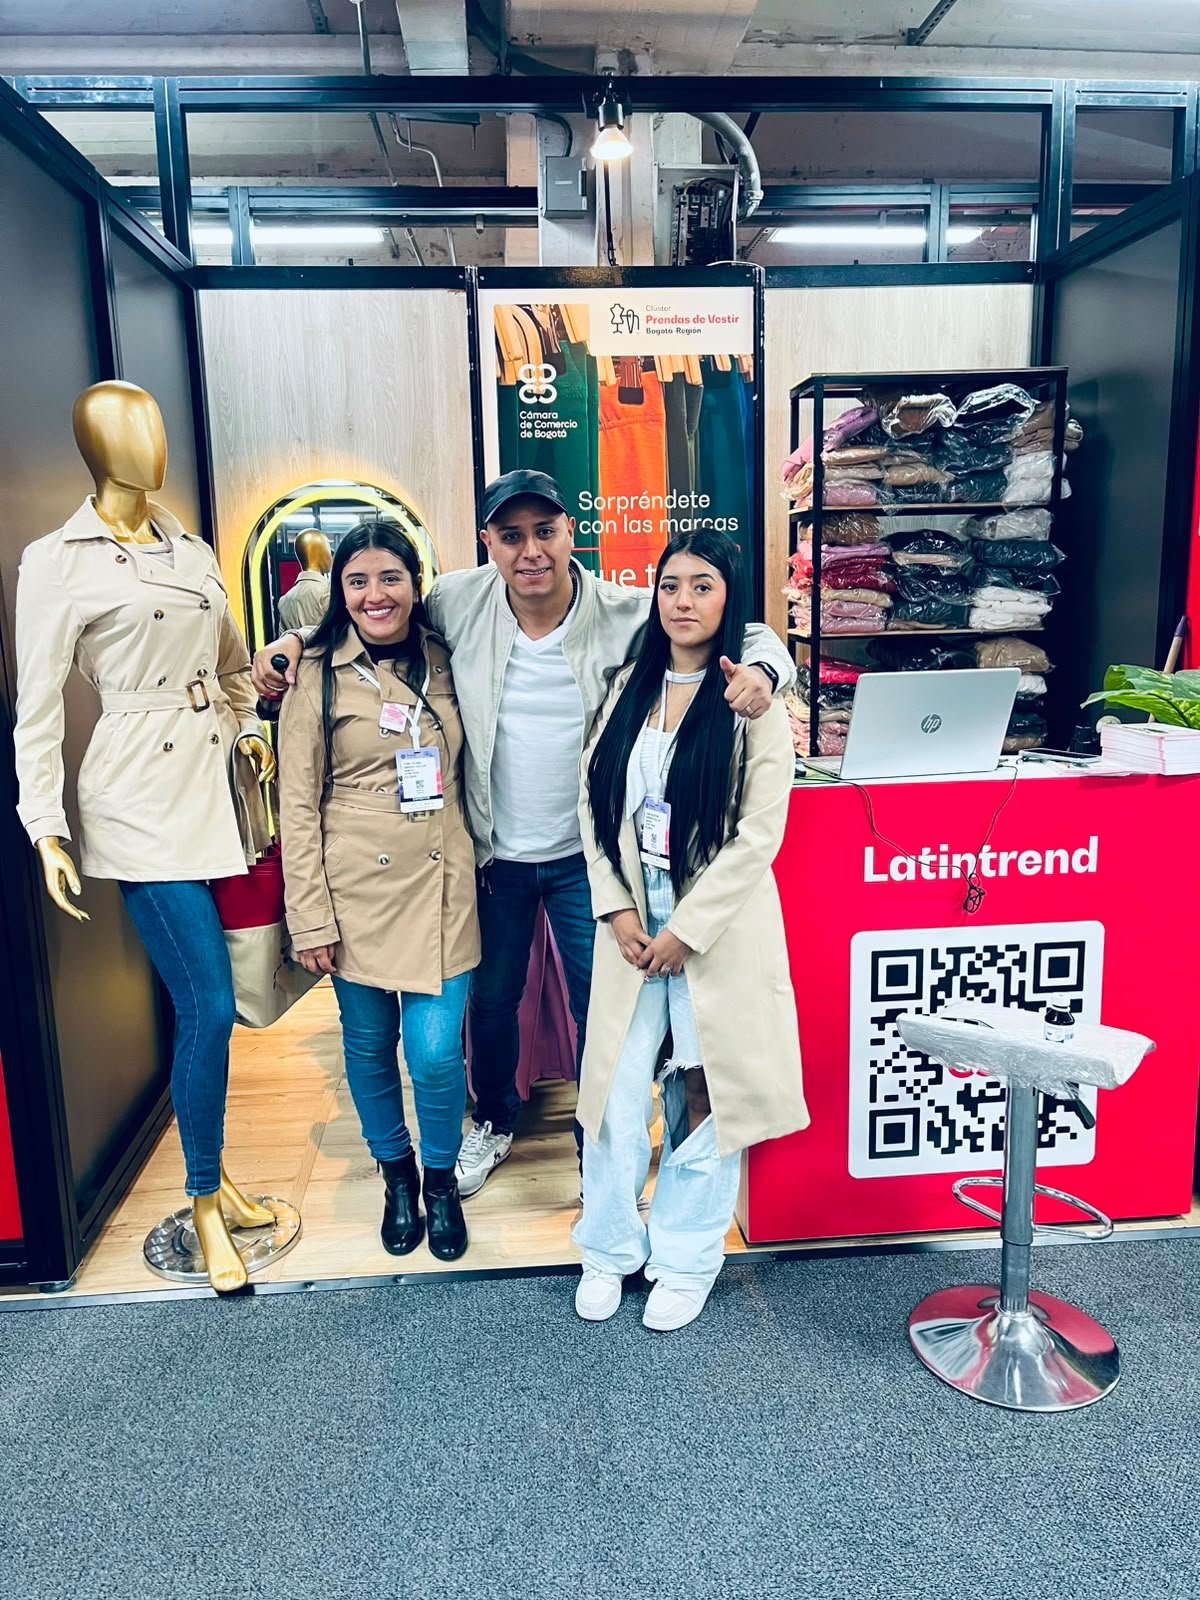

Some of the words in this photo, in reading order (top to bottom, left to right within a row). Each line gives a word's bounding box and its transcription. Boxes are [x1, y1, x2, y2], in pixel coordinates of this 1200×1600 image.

[645, 314, 690, 325] Prendas
[692, 314, 705, 324] de
[707, 313, 740, 324] Vestir
[676, 326, 702, 336] Región
[519, 410, 559, 420] Cámara
[519, 420, 533, 429] de
[534, 418, 578, 429] Comercio
[520, 429, 533, 439] de
[534, 428, 568, 440] Bogotá
[578, 488, 711, 515] Sorpréndete
[578, 519, 617, 535] con
[623, 514, 653, 533] las
[659, 516, 739, 533] marcas
[585, 568, 637, 588] ue
[922, 713, 941, 735] hp
[863, 835, 1099, 883] Latintrend
